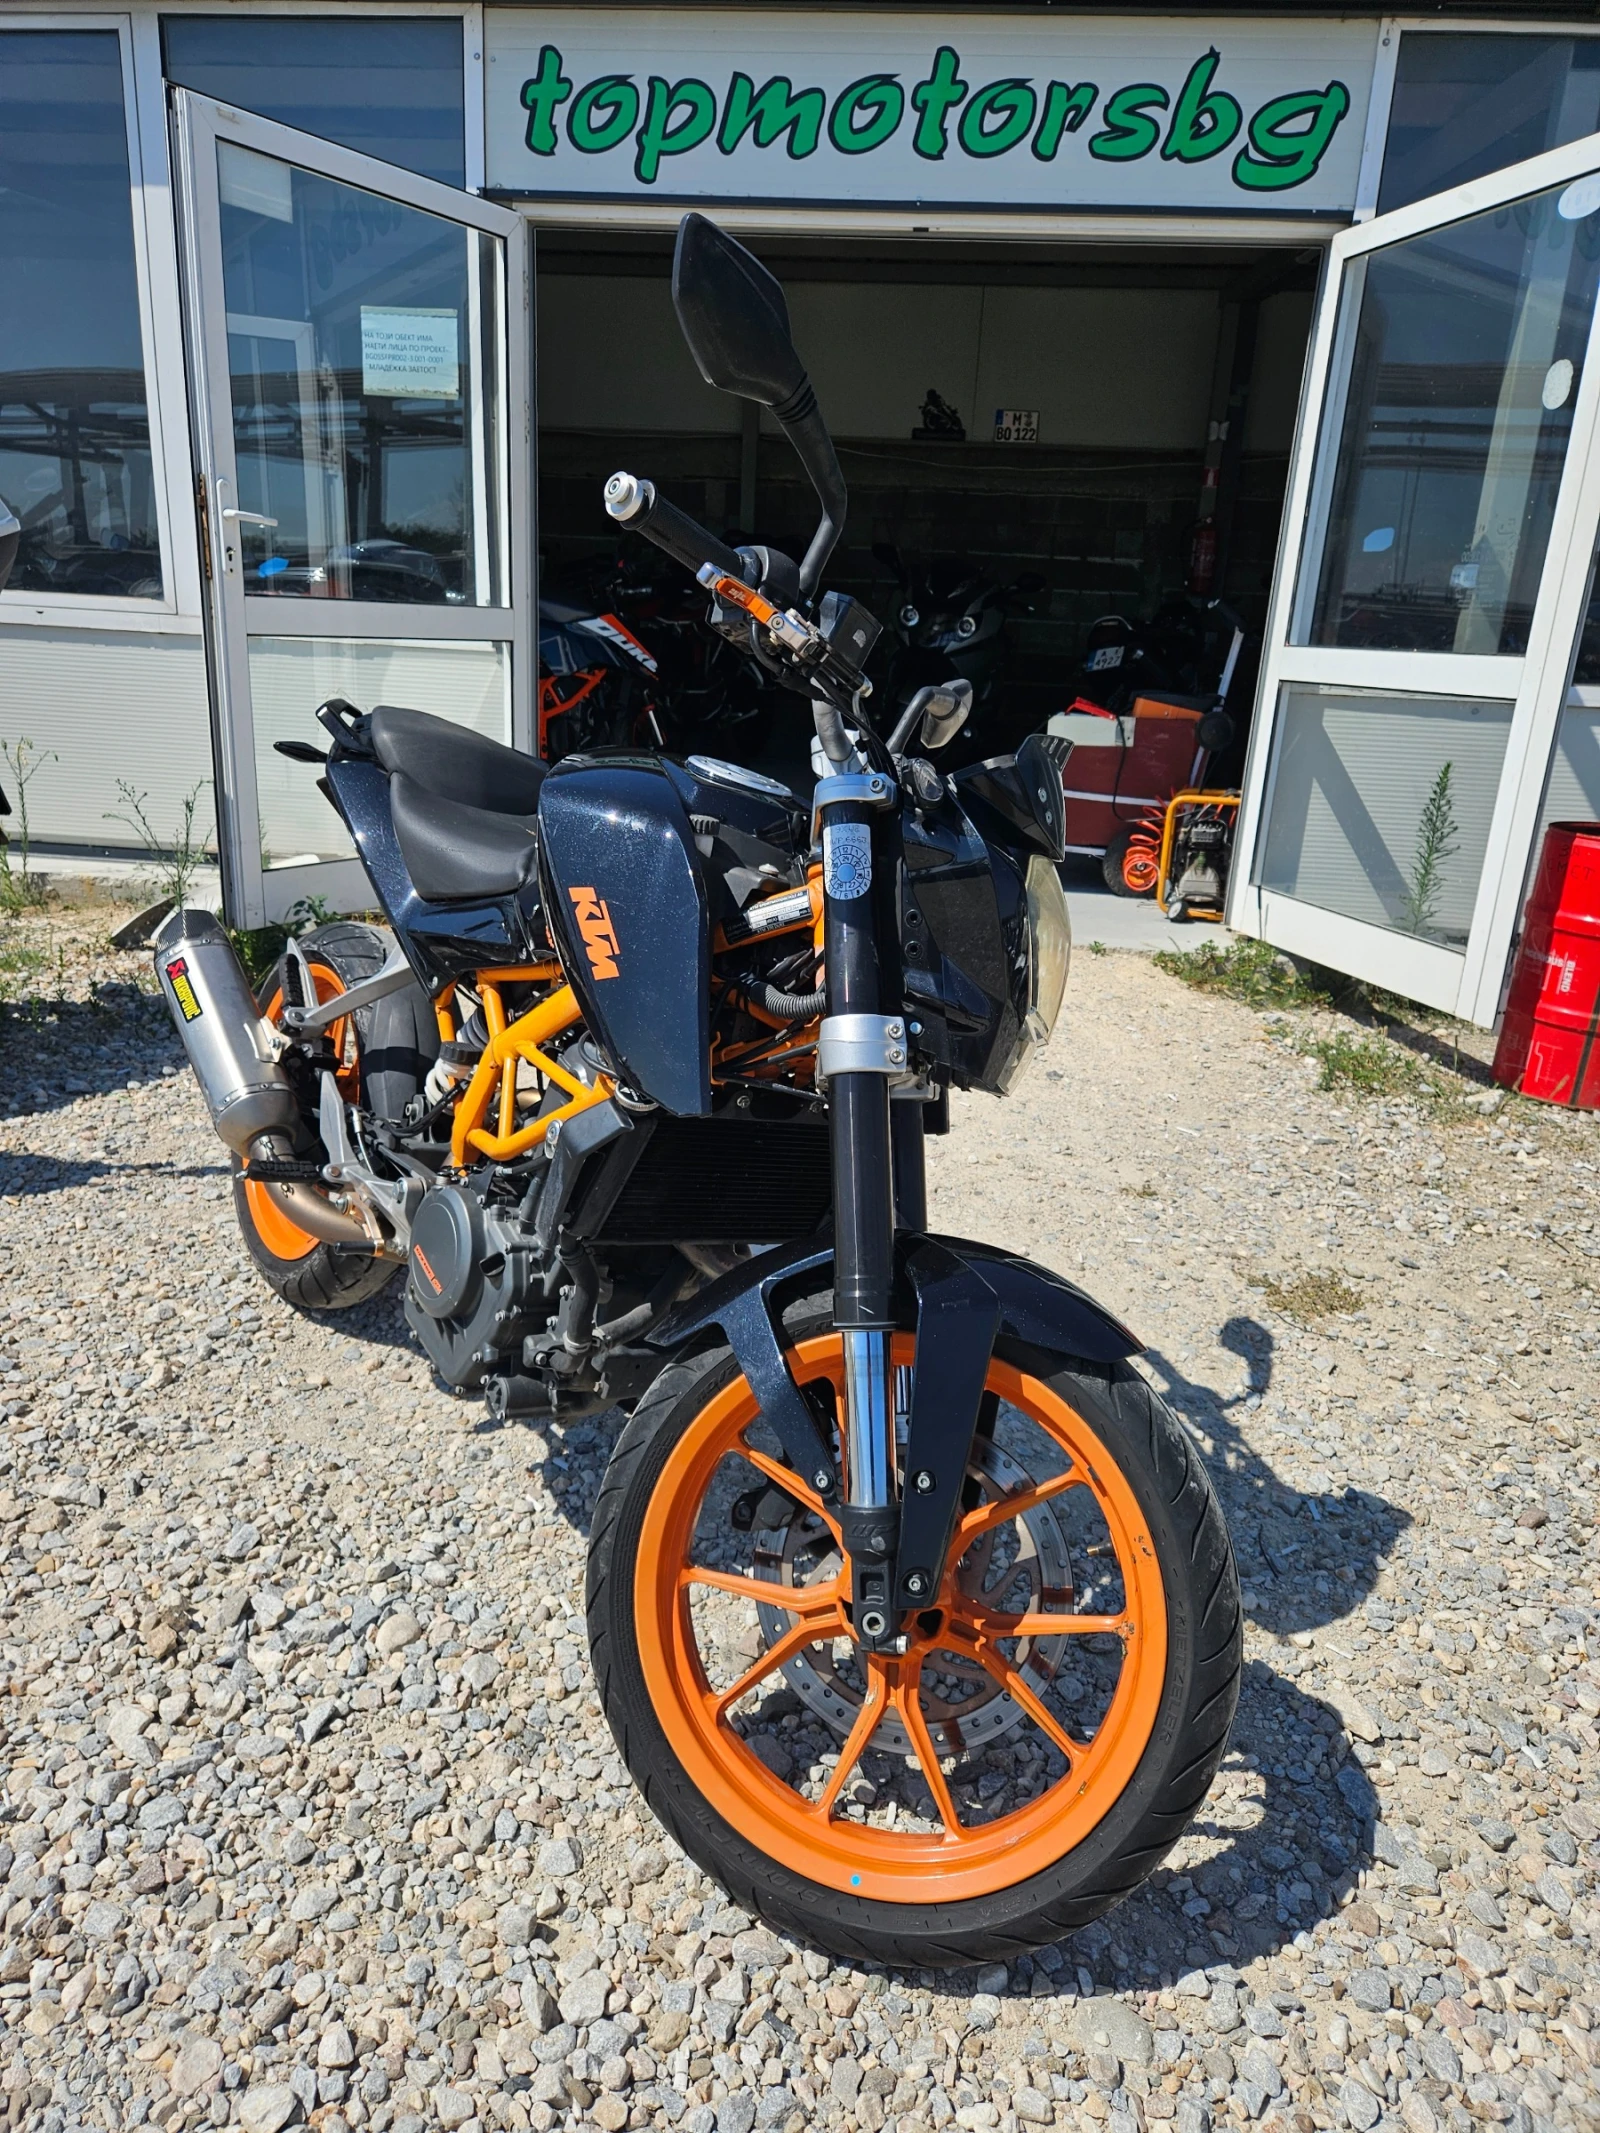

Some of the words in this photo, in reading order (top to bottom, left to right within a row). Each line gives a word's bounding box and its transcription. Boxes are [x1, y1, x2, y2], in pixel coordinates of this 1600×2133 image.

[521, 44, 1350, 191] topmotorsbg
[376, 332, 393, 340] ТОЗИ
[395, 333, 415, 341] ОБЕКТ
[417, 334, 433, 342] ИМА
[388, 344, 407, 352] ЛИЦА
[1012, 412, 1022, 426] M
[1013, 427, 1036, 441] 122
[578, 617, 658, 673] DUKE
[568, 886, 621, 981] KTM
[1560, 960, 1576, 993] BLEND
[1158, 1612, 1190, 1747] METZELER
[711, 1830, 827, 1904] SPORTEC
